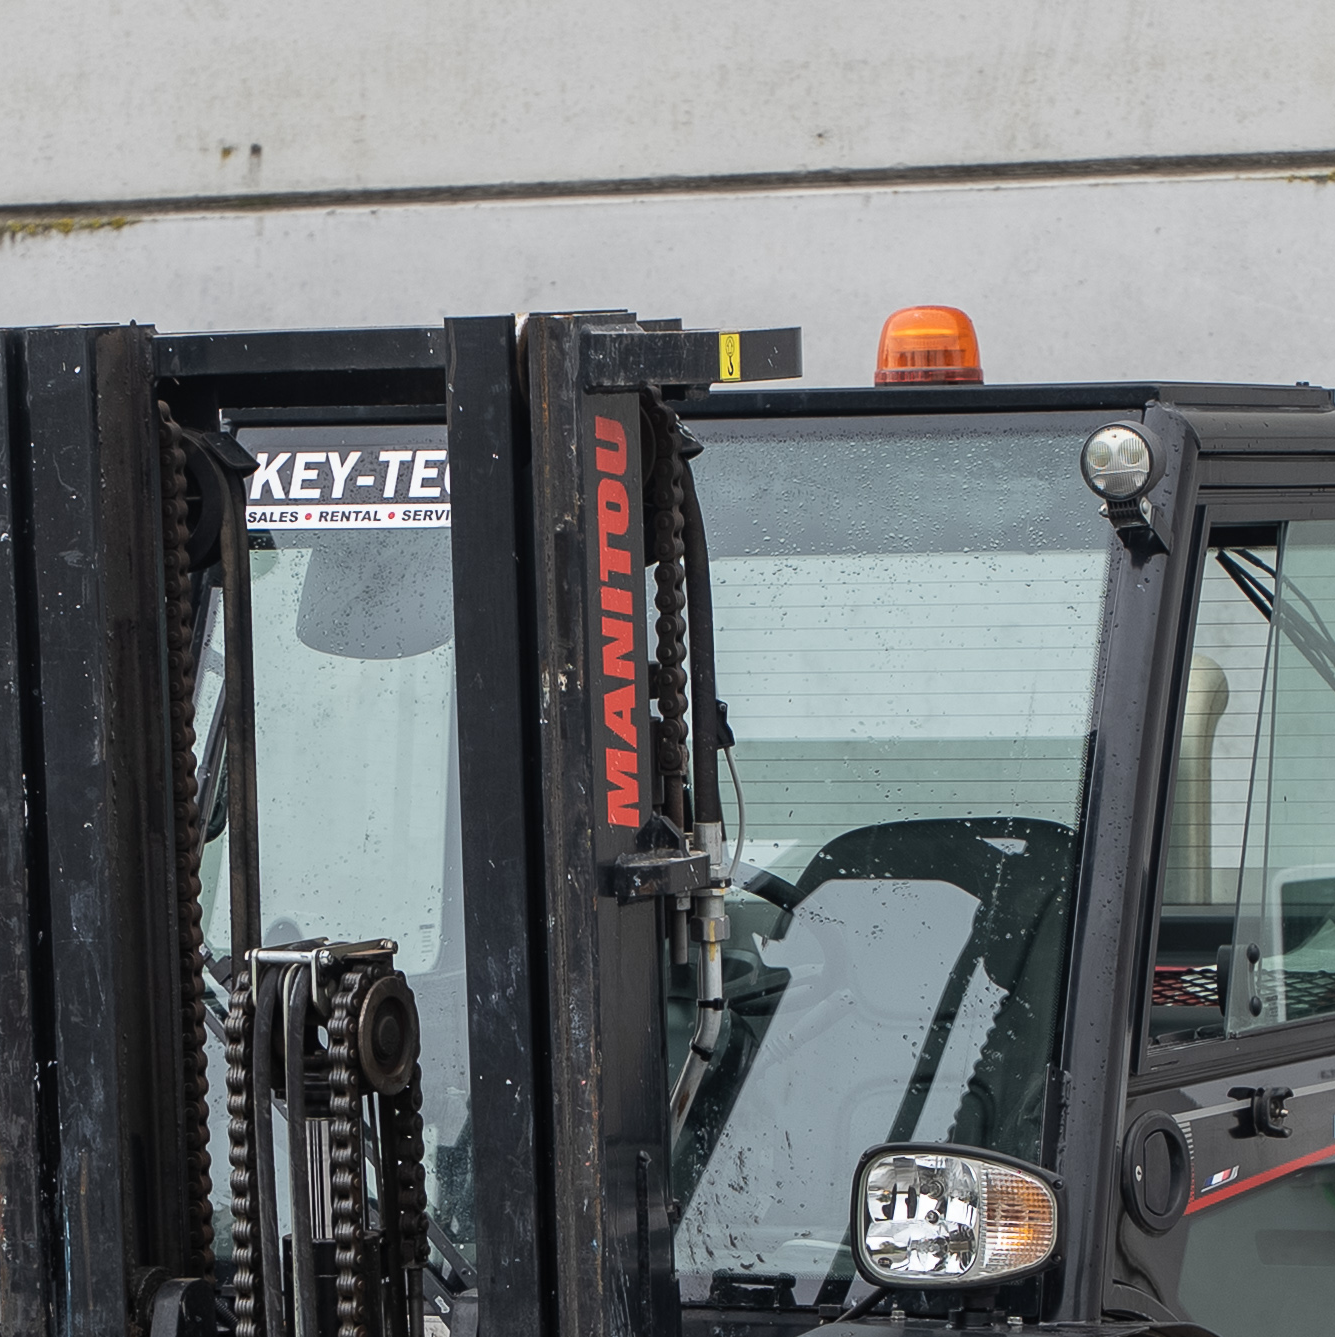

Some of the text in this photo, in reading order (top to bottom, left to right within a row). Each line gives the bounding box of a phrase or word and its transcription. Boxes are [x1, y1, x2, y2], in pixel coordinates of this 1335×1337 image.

[249, 450, 450, 499] KEY-TE
[247, 509, 450, 523] SALES RENTAL SERVI
[595, 415, 640, 828] MANITOU
